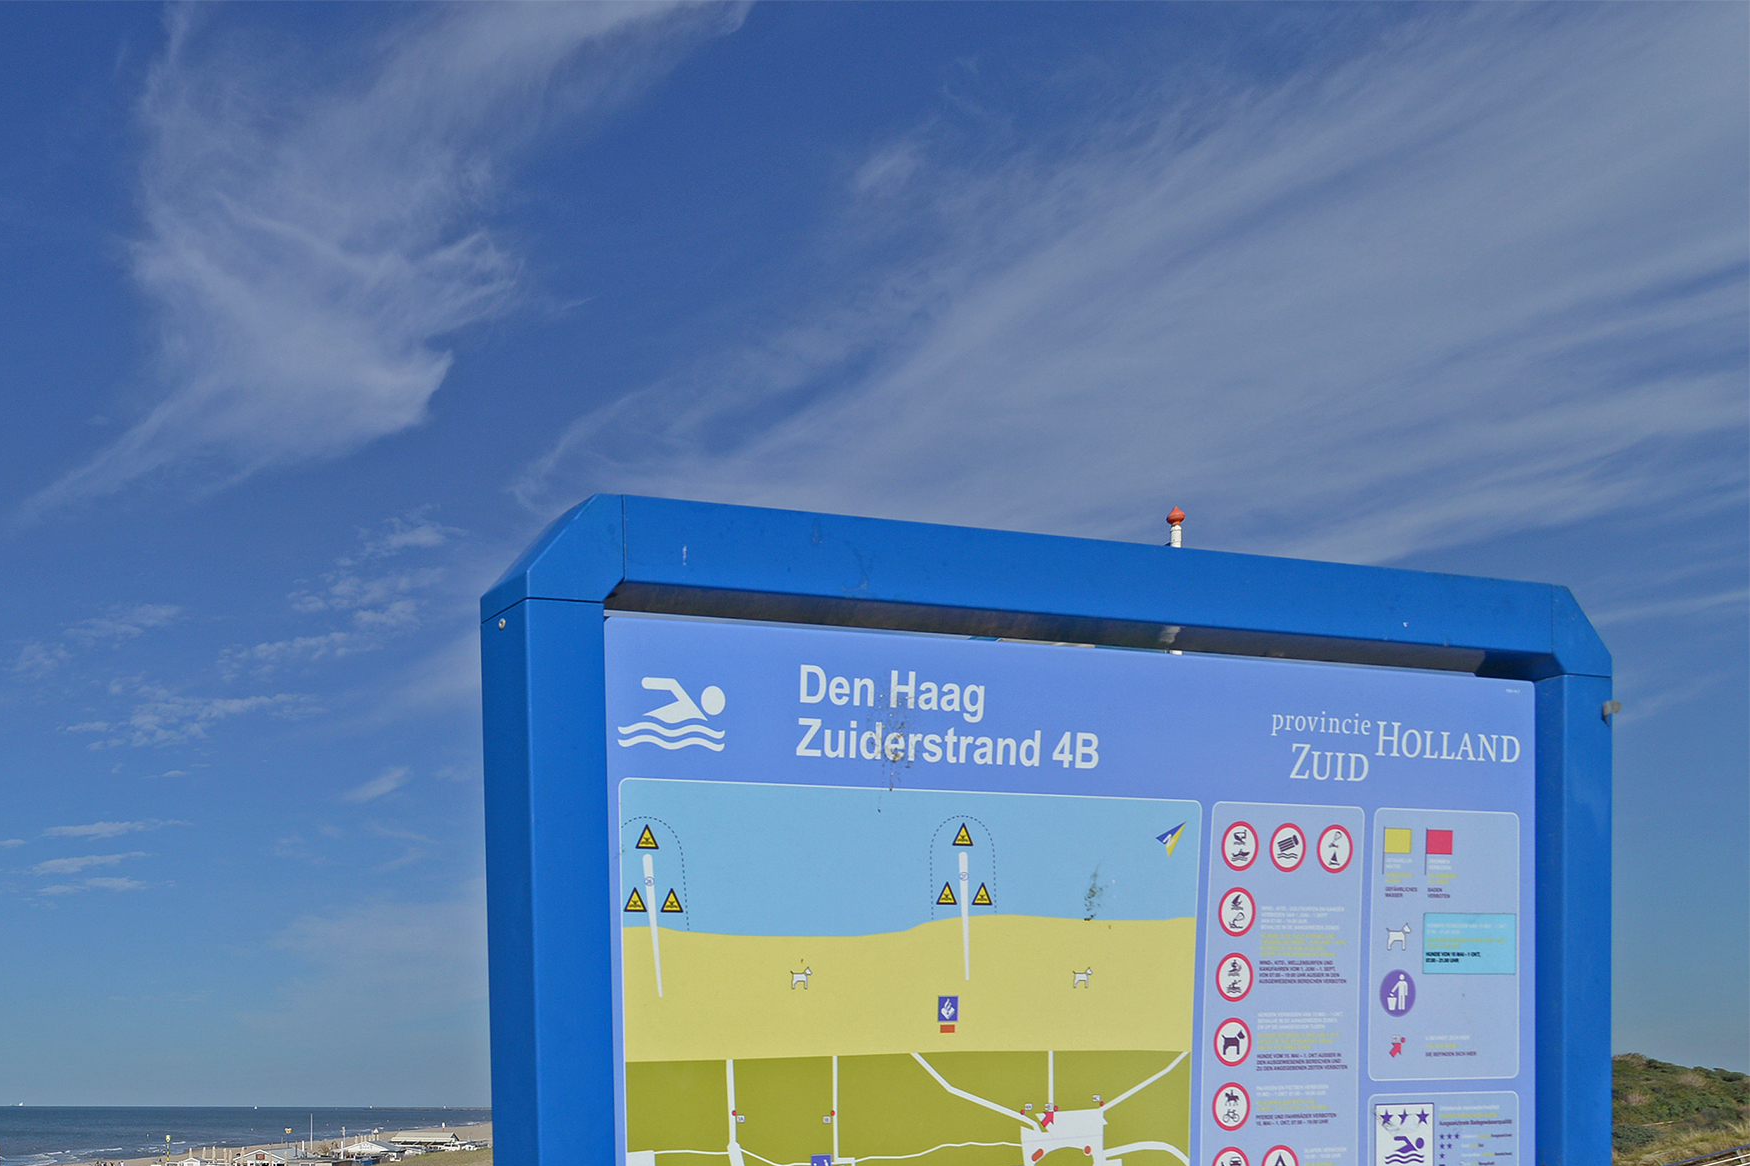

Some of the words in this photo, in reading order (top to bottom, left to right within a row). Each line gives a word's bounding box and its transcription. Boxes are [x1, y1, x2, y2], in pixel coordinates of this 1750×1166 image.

[799, 664, 883, 706] Den
[889, 670, 985, 723] Haag
[796, 718, 1041, 768] Zuiderstrand
[1052, 731, 1099, 768] 4B
[1270, 711, 1371, 736] provincie
[1375, 721, 1520, 762] HOLLAND
[1289, 743, 1368, 781] ZUID
